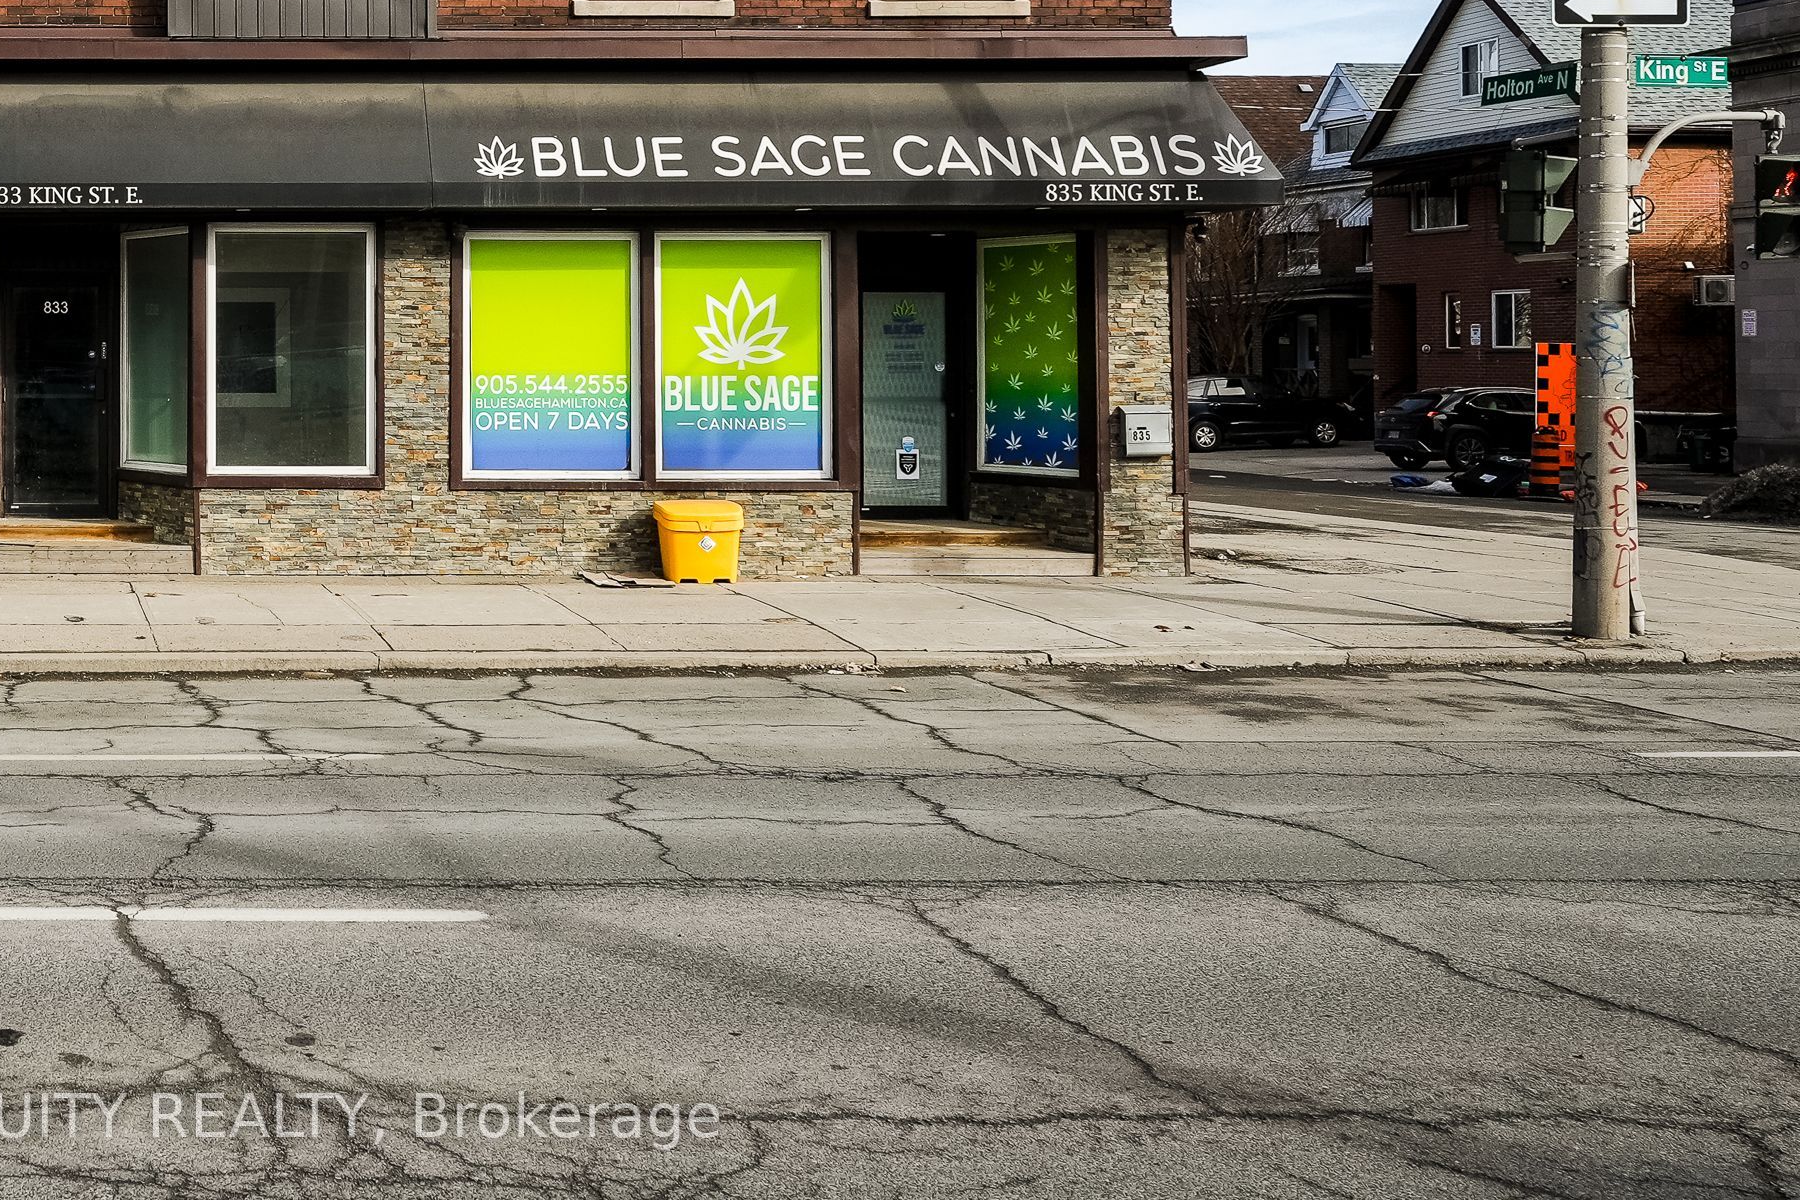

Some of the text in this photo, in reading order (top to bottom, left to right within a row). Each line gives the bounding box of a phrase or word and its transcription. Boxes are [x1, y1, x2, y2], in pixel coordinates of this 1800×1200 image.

[1640, 60, 1726, 84] King St E
[1486, 69, 1569, 100] Holton Ave N
[531, 134, 1206, 177] BLUE SAGE CANNABIS
[29, 186, 83, 204] KING
[88, 186, 119, 204] ST.
[126, 186, 143, 204] E.
[1045, 183, 1204, 202] 835 KING ST. E.
[43, 301, 69, 314] 833
[475, 375, 628, 395] 905.544.2555
[664, 375, 819, 412] BLUE SAGE
[475, 398, 628, 409] BLUESAGEHAMILTON.CA
[475, 412, 629, 431] OPEN 7 DAYS
[696, 417, 787, 431] CANNABIS
[1133, 431, 1151, 441] 835
